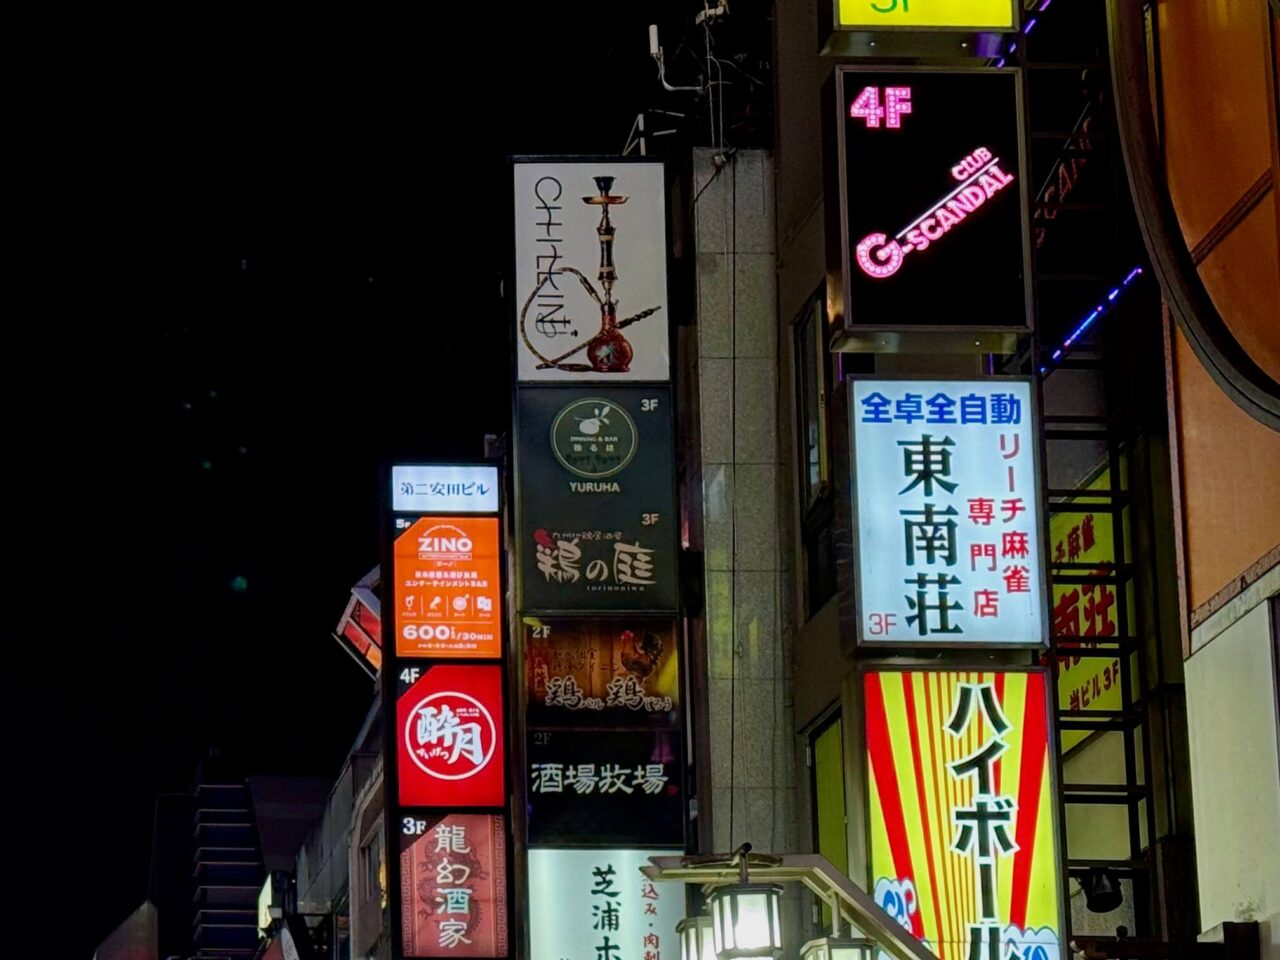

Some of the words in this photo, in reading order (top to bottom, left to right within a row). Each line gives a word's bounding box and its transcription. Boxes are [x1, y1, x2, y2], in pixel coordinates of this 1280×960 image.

[851, 86, 912, 128] 4F
[951, 146, 993, 181] CLUB
[856, 165, 1015, 278] G-SCANDAL
[640, 399, 659, 411] 3F
[861, 392, 1022, 425] 全卓全自動
[400, 481, 490, 497] 第二安田ビル
[569, 481, 620, 493] YURUHA
[641, 513, 660, 525] 3F
[999, 433, 1031, 594] リーチ麻雀
[418, 537, 472, 552] ZINO
[896, 434, 964, 636] 東南荘
[967, 498, 999, 618] 専門店
[531, 626, 552, 639] 2F
[868, 613, 897, 636] 3F
[400, 668, 419, 683] 4F
[531, 763, 669, 795] 酒場牧場
[403, 817, 426, 834] 3F
[434, 823, 472, 948] 龍幻酒家
